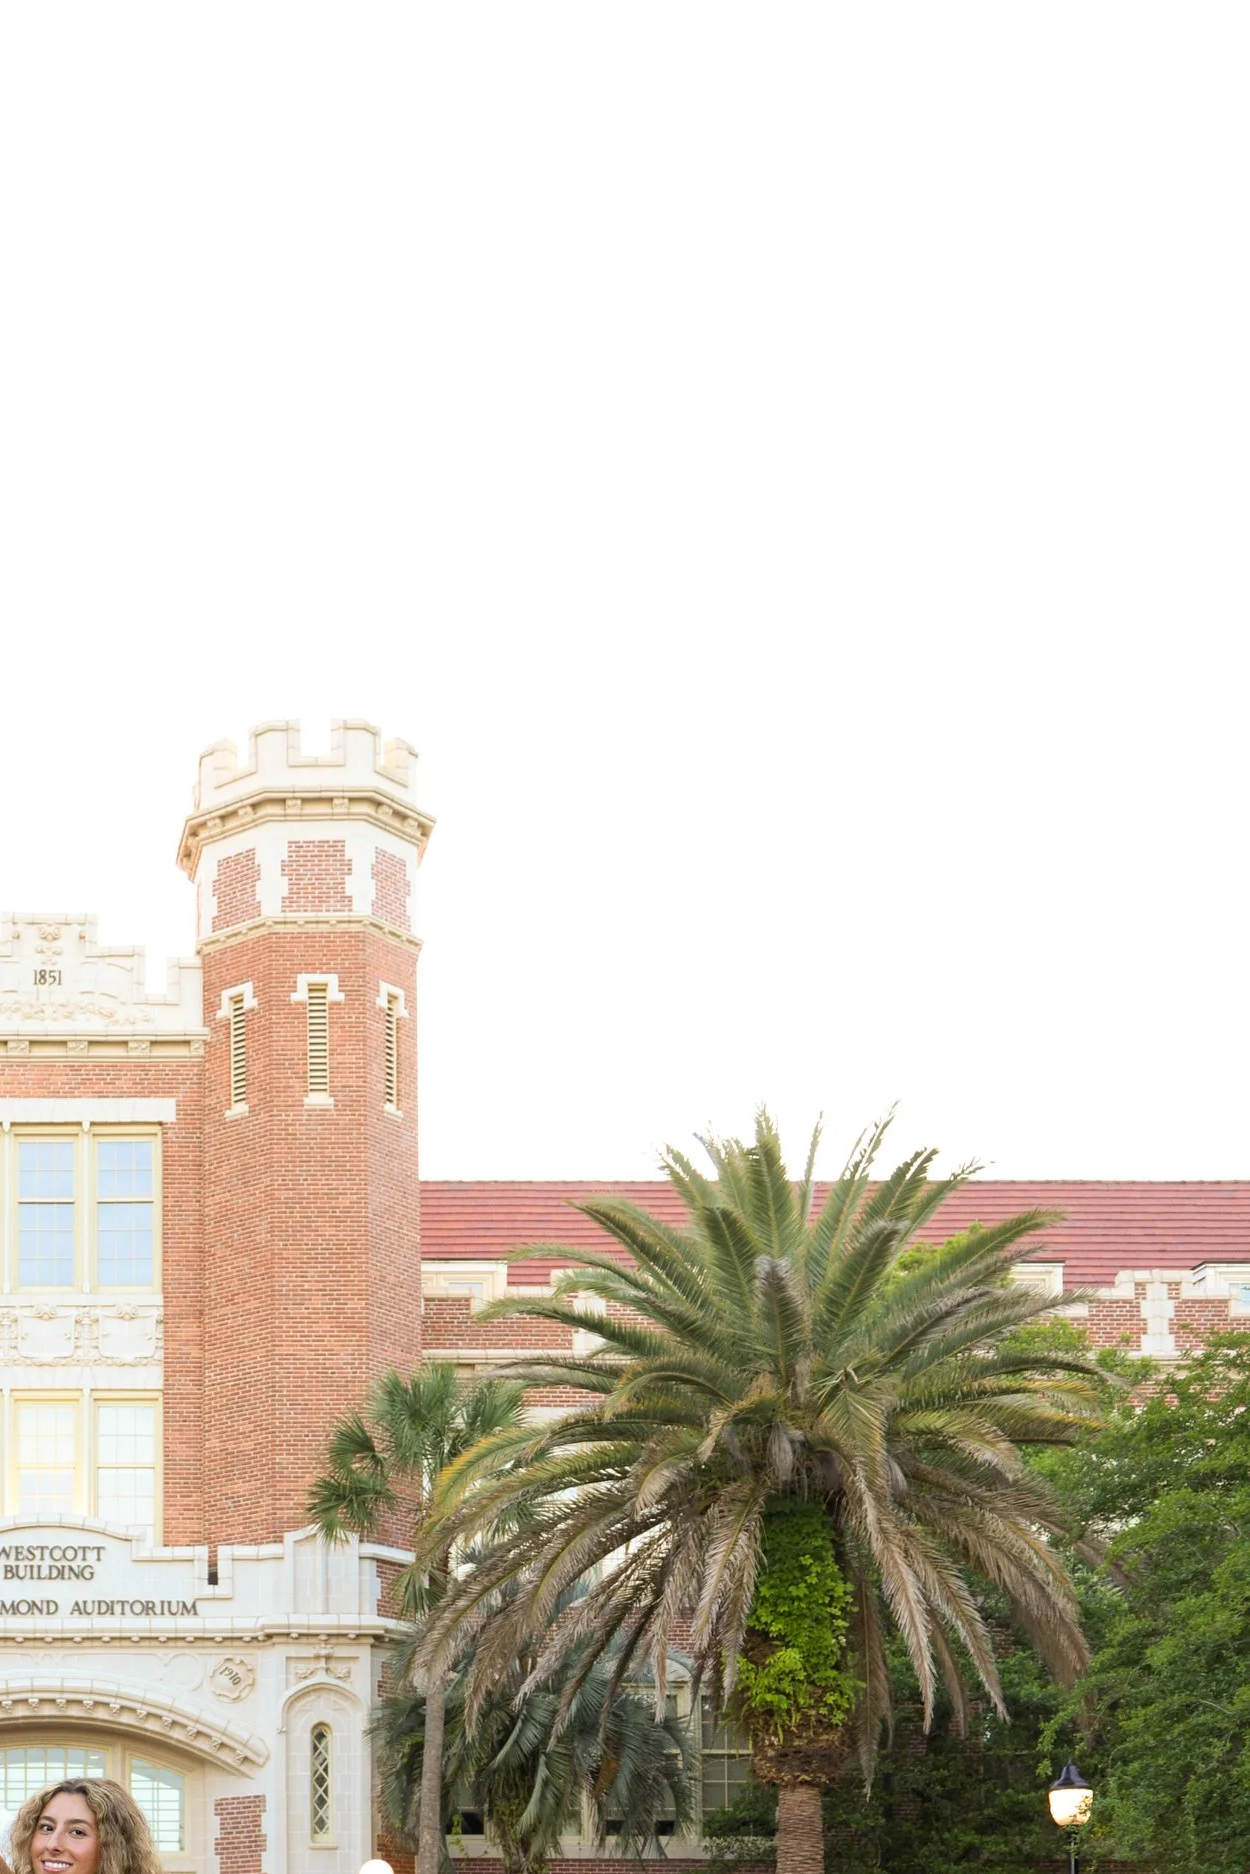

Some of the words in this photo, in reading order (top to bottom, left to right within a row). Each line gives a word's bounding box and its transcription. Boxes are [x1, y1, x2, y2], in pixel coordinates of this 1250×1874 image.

[33, 969, 62, 985] 1851
[3, 1564, 96, 1581] BUILDING
[70, 1600, 198, 1616] AUDITORIUM
[219, 1666, 242, 1686] 1910
